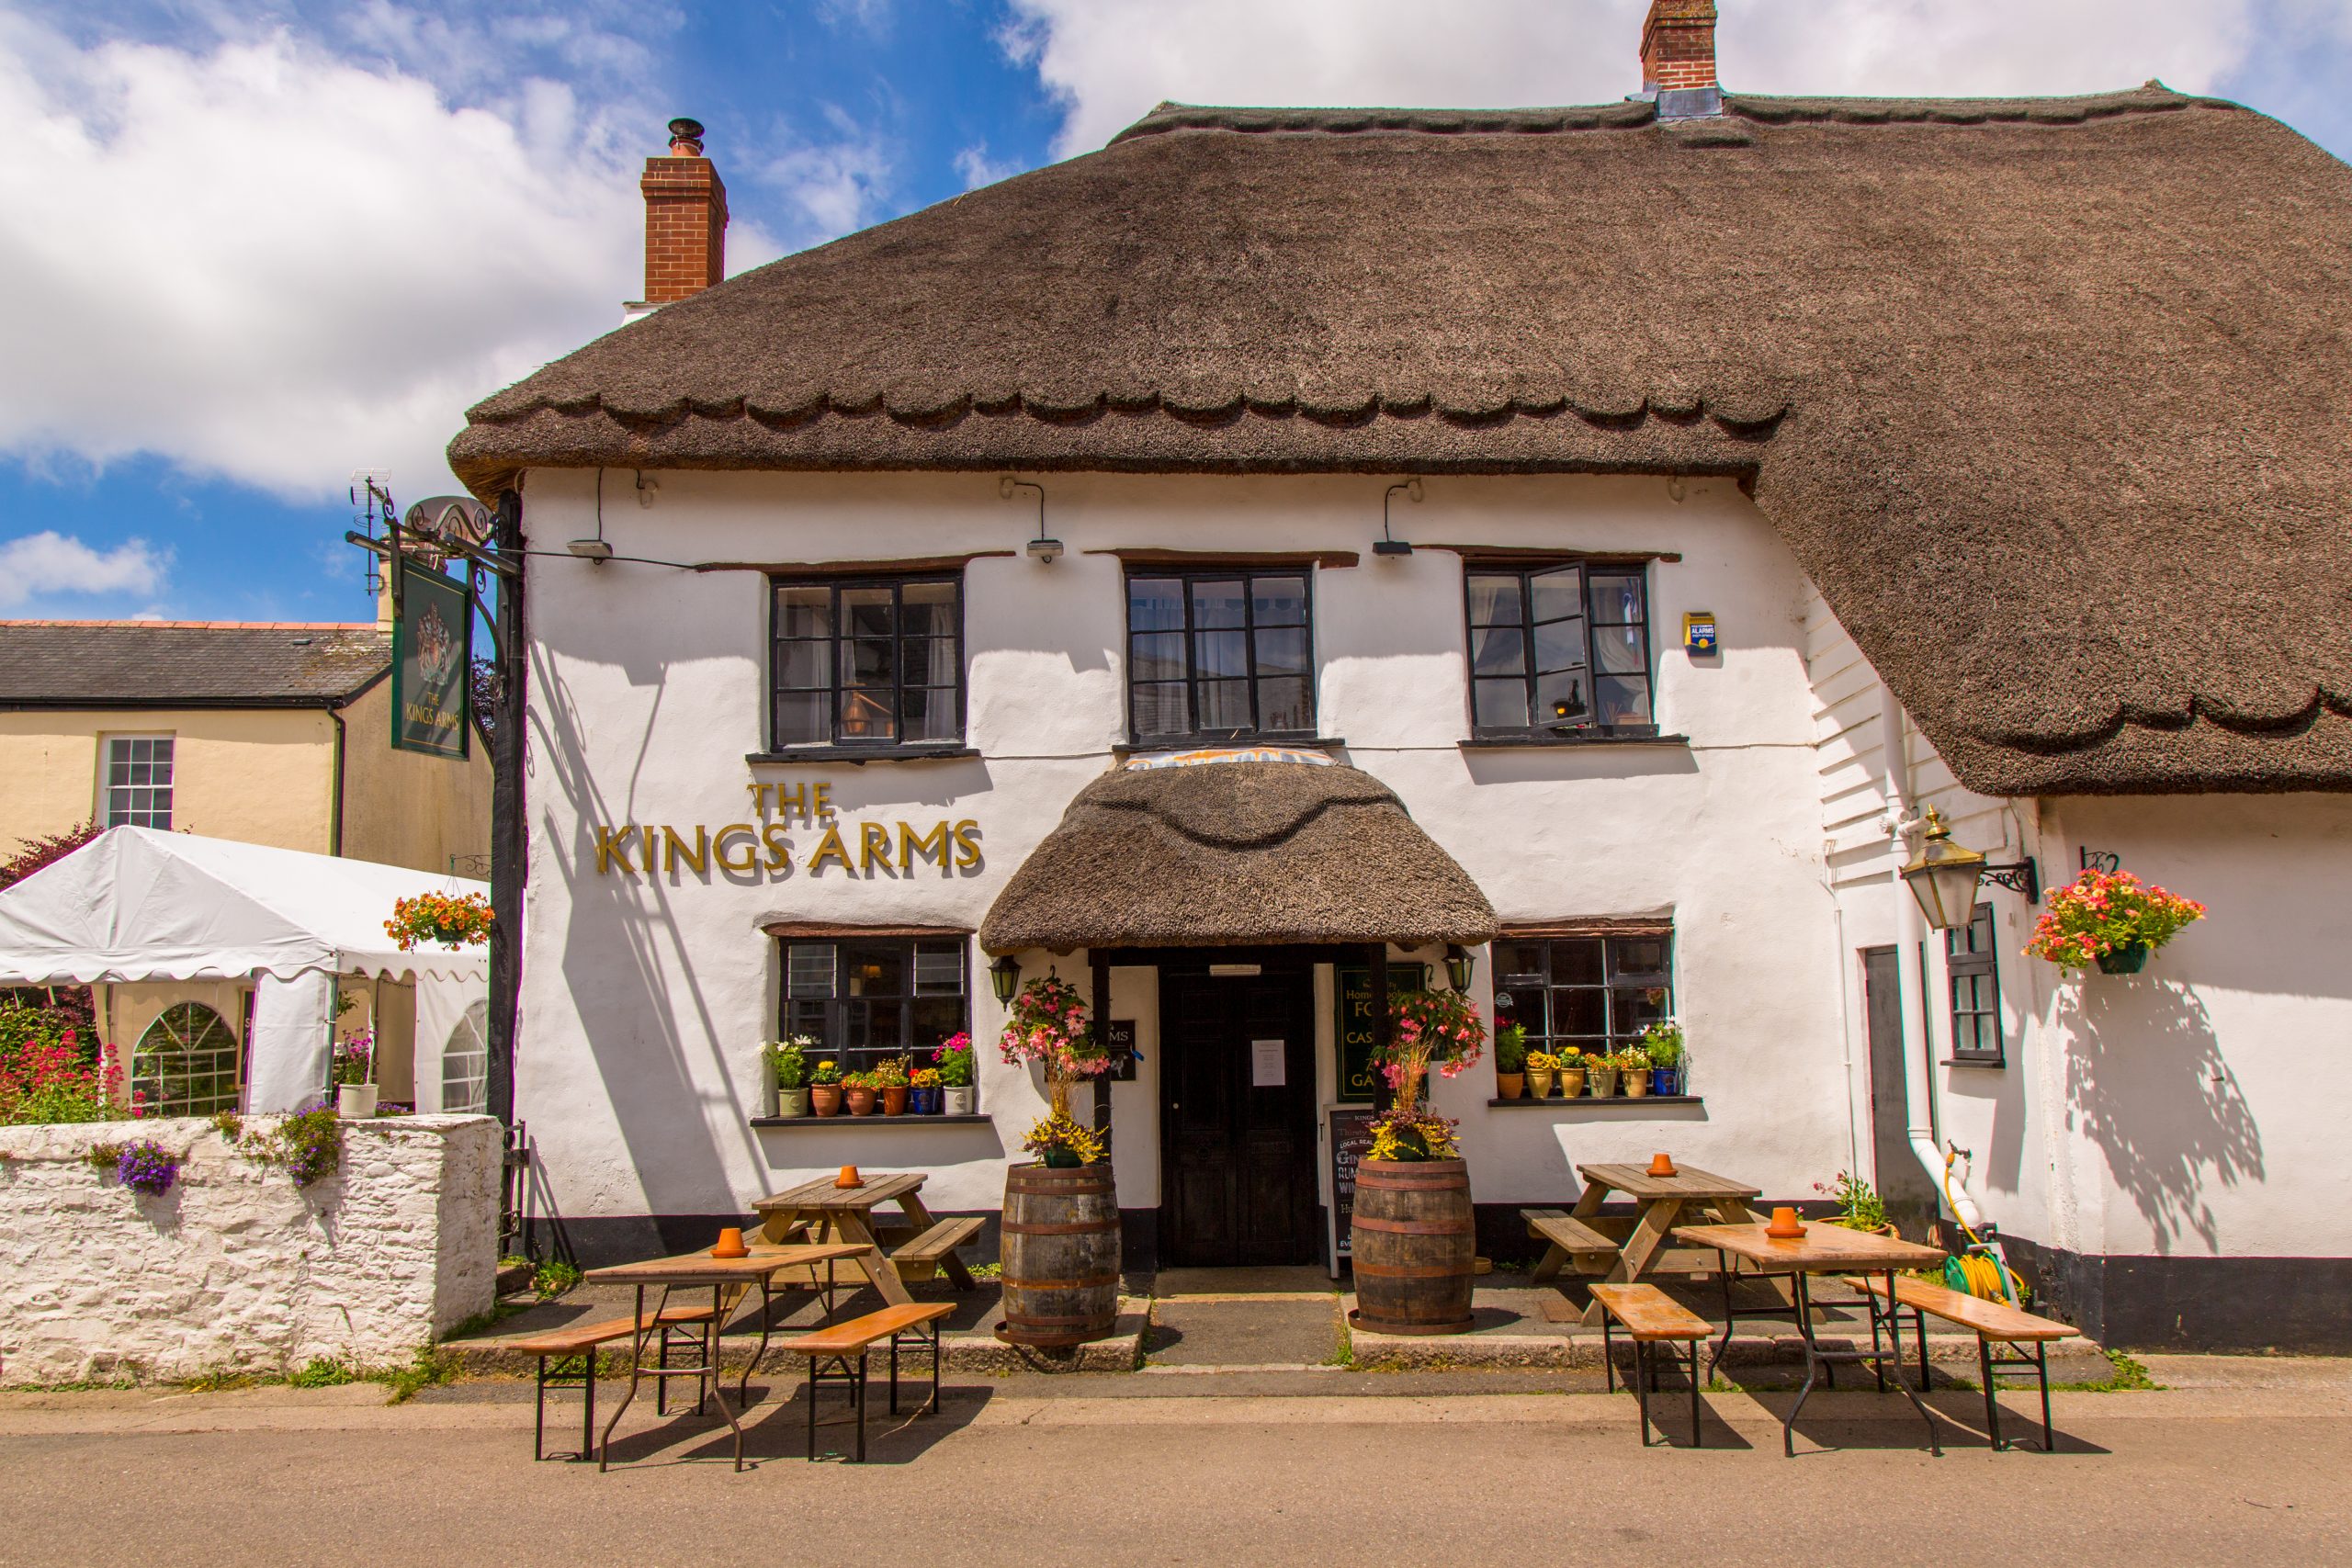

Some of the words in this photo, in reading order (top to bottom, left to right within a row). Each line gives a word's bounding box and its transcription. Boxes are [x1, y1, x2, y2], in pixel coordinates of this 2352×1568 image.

[427, 691, 440, 706] THE
[406, 701, 434, 725] KINGS
[435, 710, 458, 731] ARMS
[747, 783, 832, 818] THE
[596, 823, 790, 874] KINGS
[808, 819, 981, 870] ARMS
[1340, 1139, 1358, 1149] LOCAL
